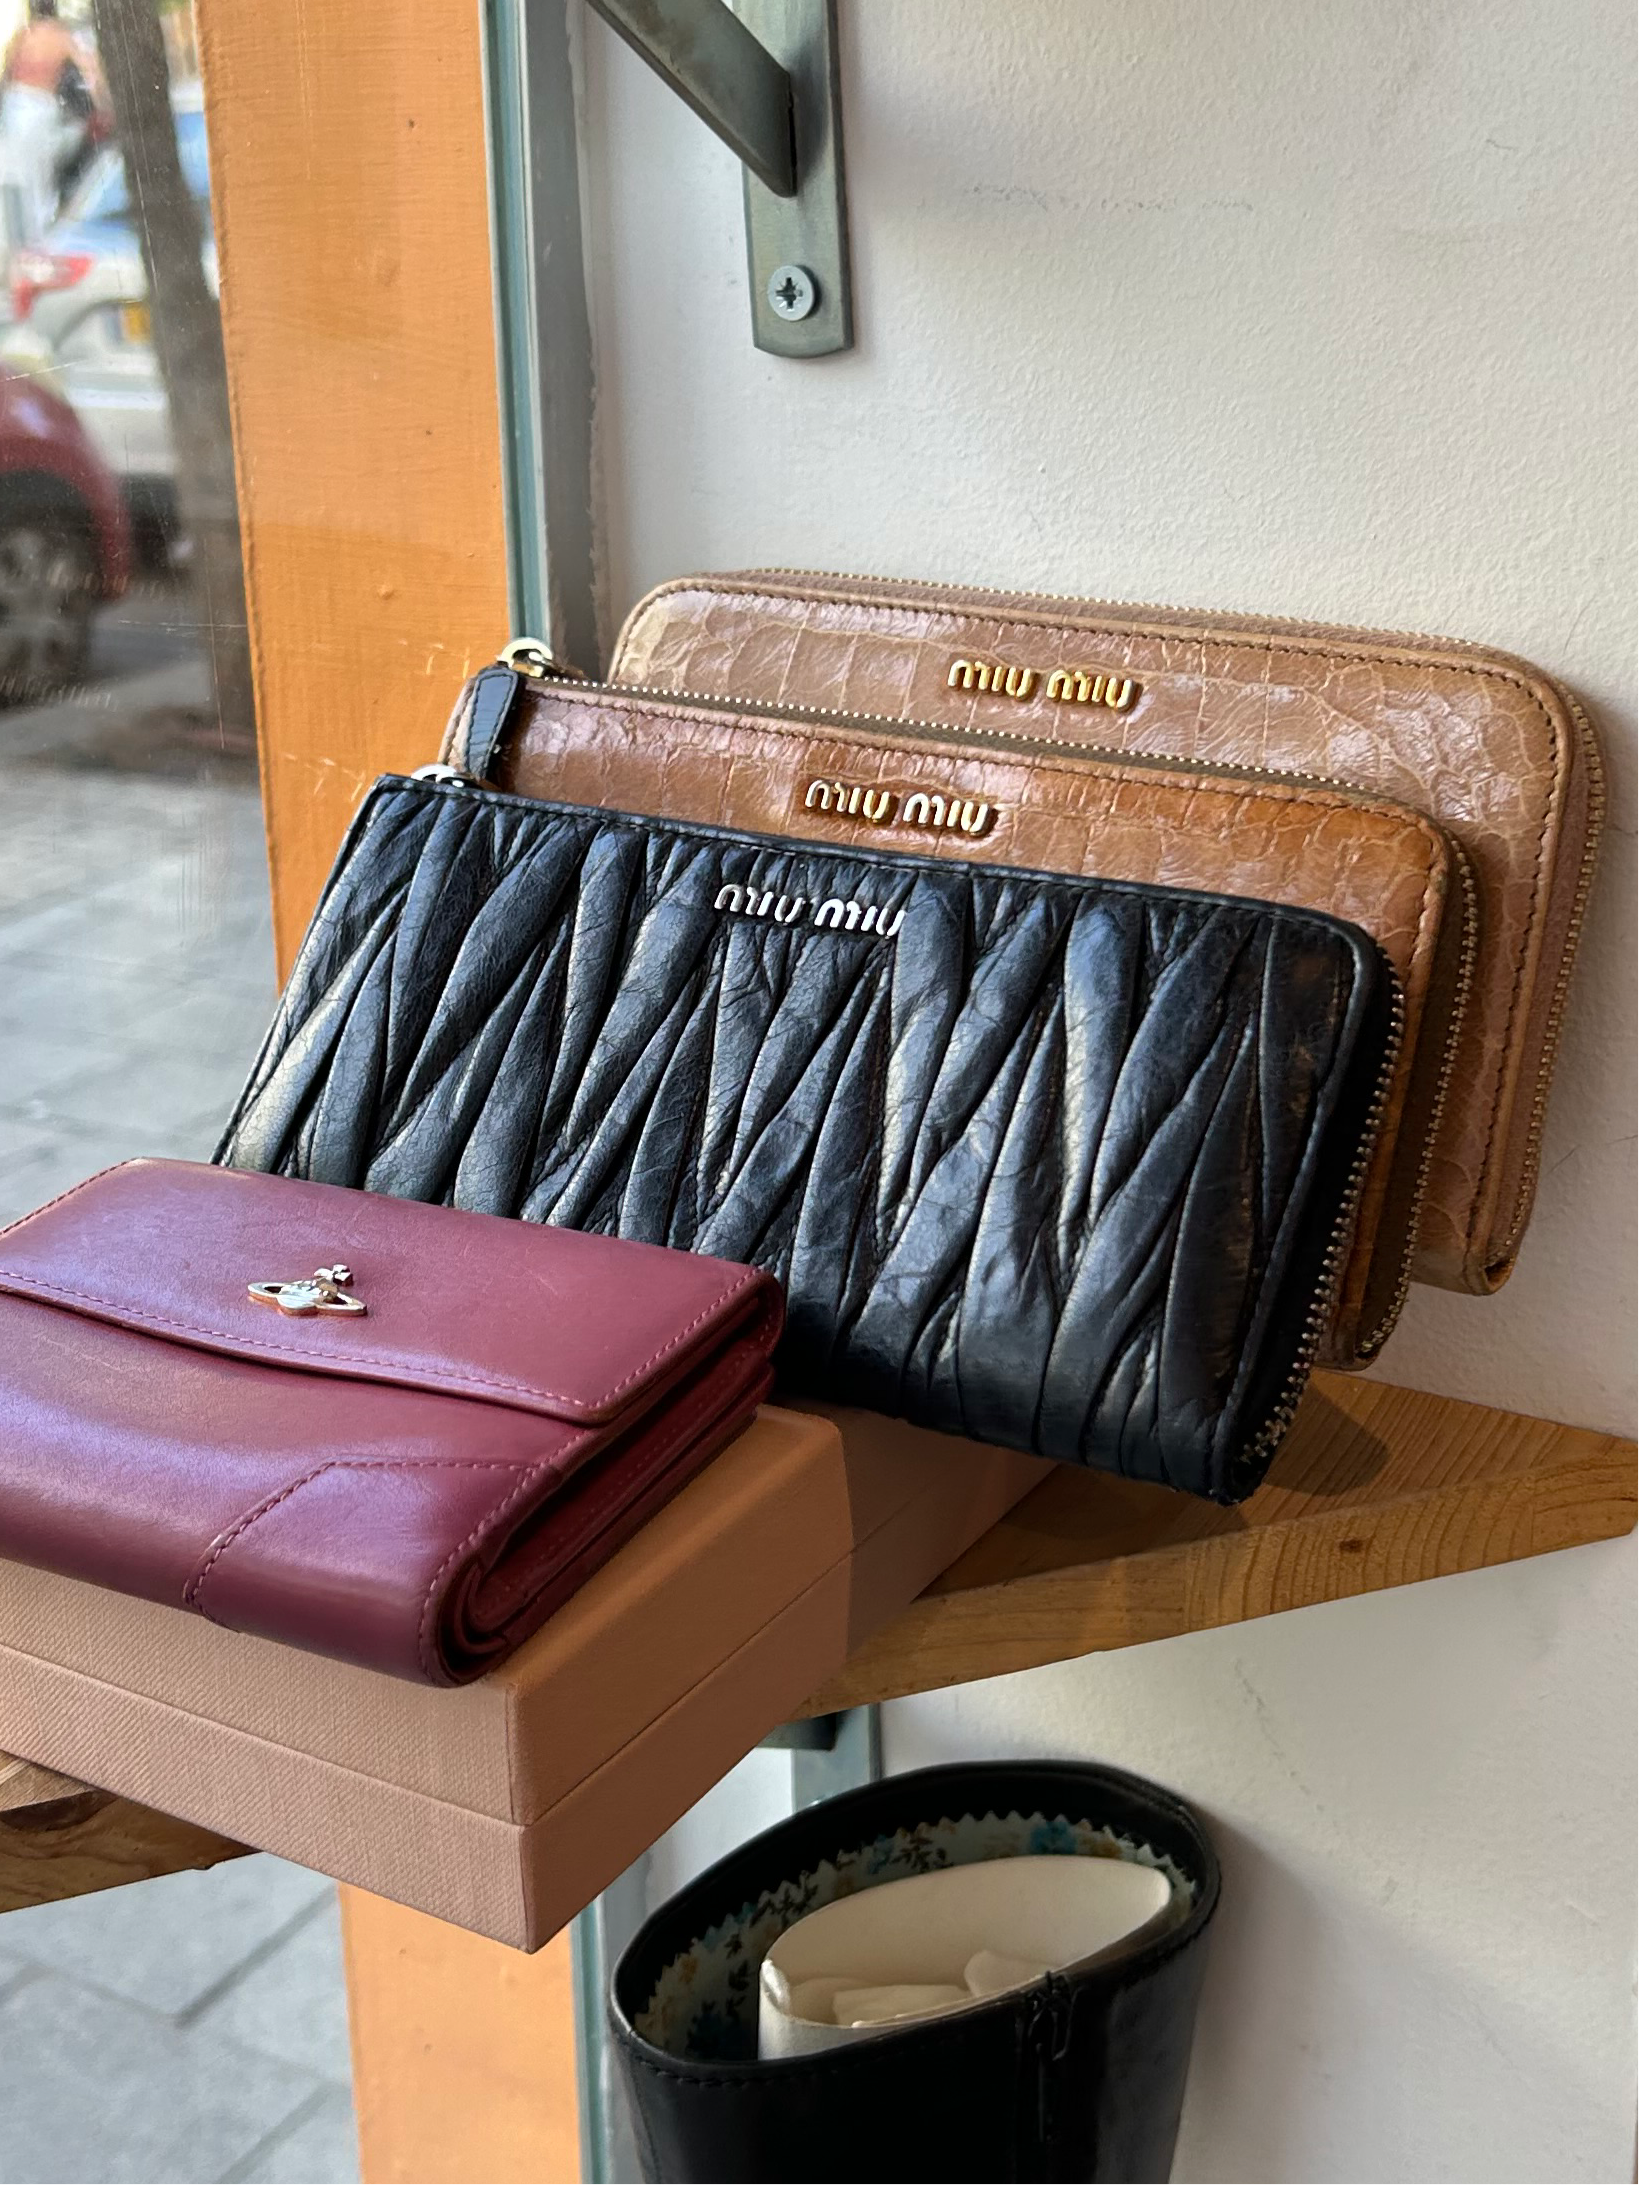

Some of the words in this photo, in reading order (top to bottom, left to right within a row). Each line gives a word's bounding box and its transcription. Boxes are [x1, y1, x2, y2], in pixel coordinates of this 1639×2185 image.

[947, 659, 1031, 698] miu
[1046, 669, 1133, 709] miu
[804, 779, 890, 823] miu
[902, 793, 989, 836] miu
[714, 884, 805, 926] miu
[814, 898, 906, 939] miu
